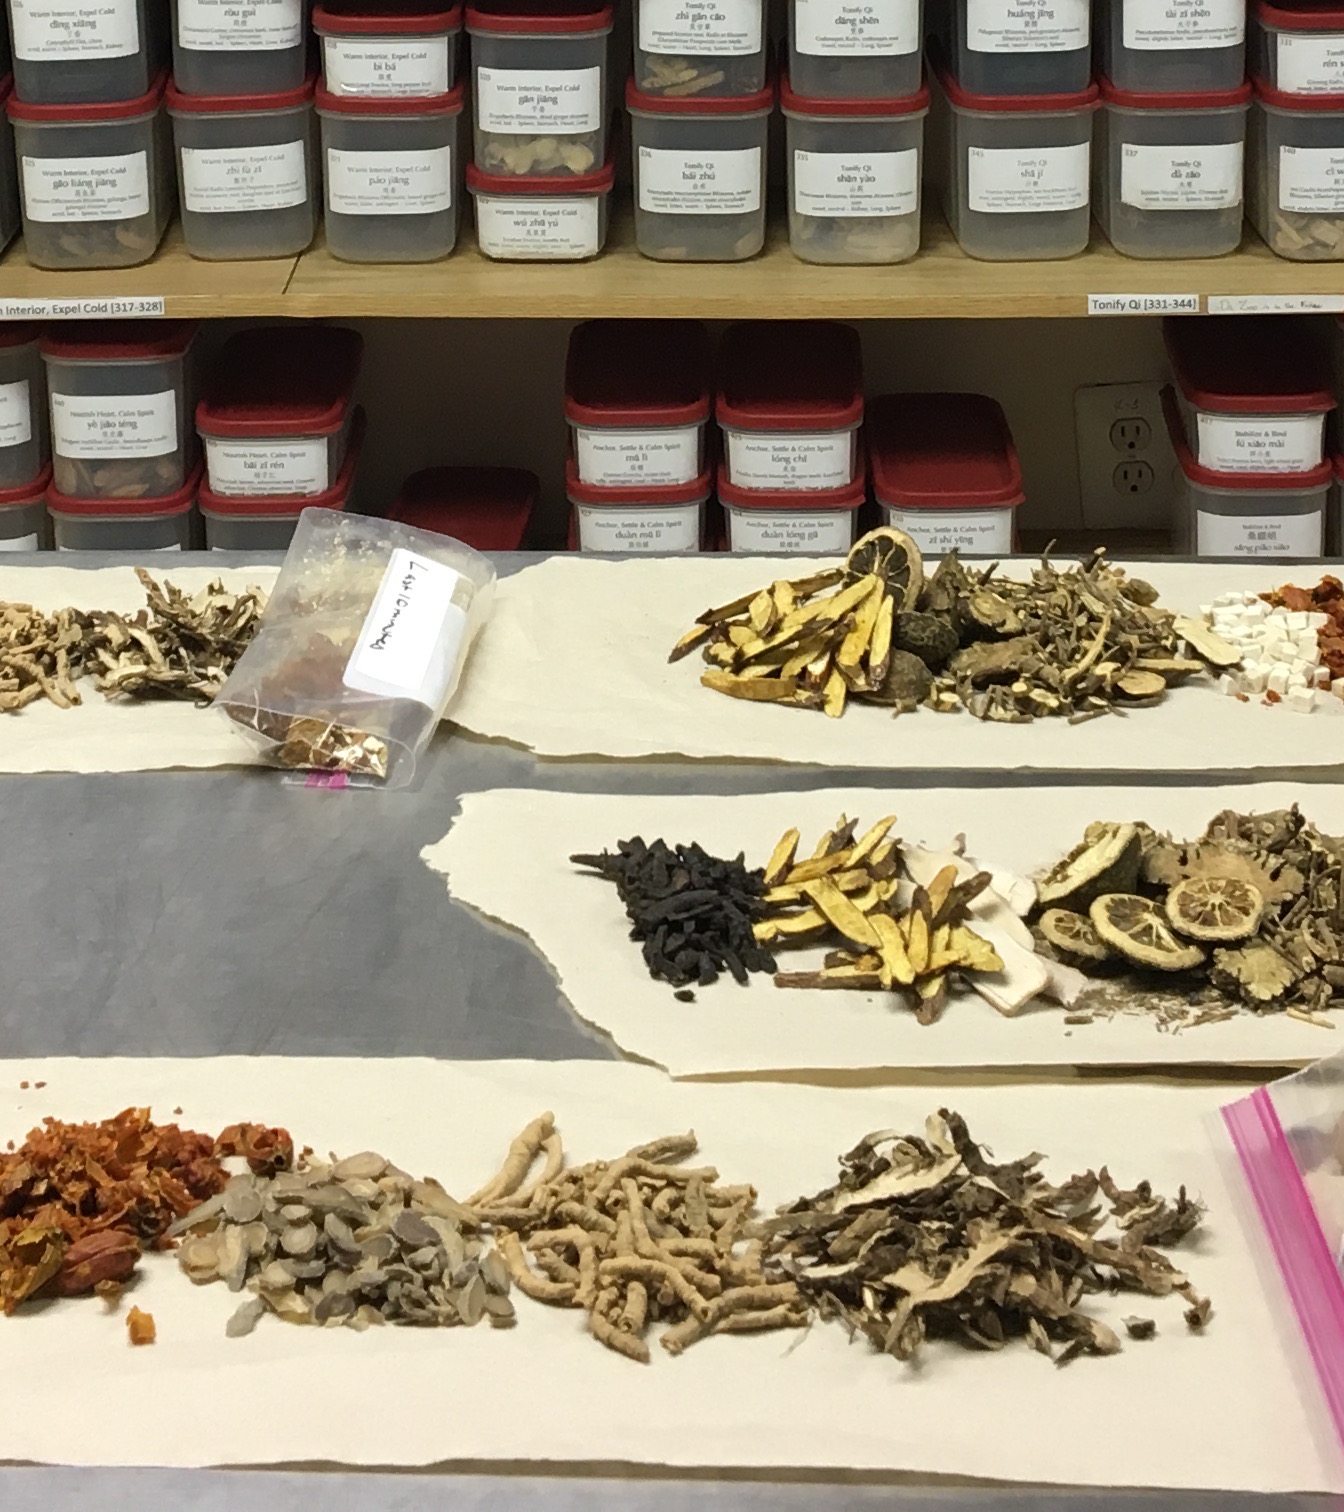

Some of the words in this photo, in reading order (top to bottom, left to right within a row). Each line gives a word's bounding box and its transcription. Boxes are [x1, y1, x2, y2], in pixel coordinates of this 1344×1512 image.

[6, 303, 49, 316] Interior,
[52, 303, 80, 316] Expel
[83, 302, 108, 313] Cold
[111, 301, 163, 315] [317-328]
[1092, 299, 1126, 312] Tonify
[1129, 300, 1141, 311] Qi
[1144, 298, 1197, 312] [331-344]
